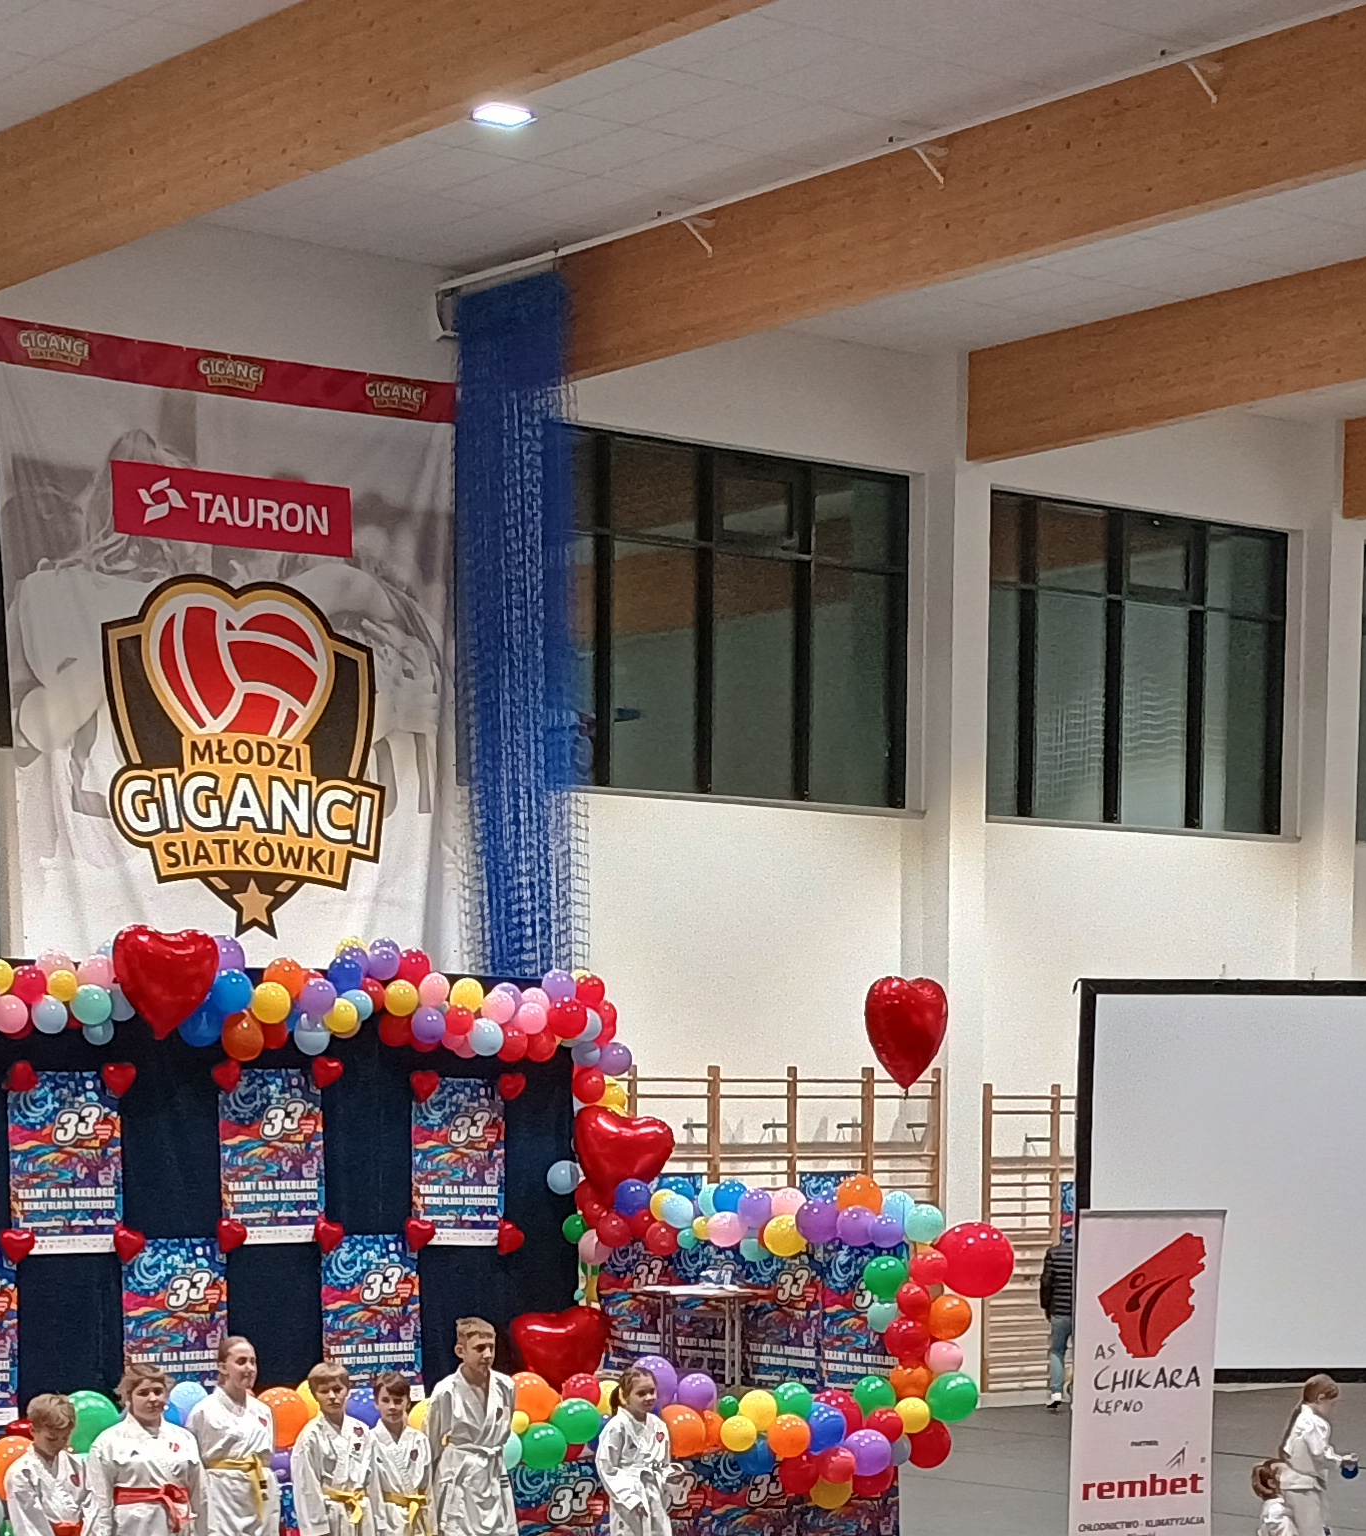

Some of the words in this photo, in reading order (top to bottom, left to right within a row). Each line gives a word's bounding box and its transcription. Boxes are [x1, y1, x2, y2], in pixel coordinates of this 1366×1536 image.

[19, 332, 89, 358] GIGANCI
[199, 359, 264, 383] GIGANCI
[366, 382, 427, 405] GIGANCI
[191, 490, 329, 535] TAURON
[189, 738, 303, 774] MŁODZI
[122, 775, 373, 848] GIGANCI
[166, 834, 336, 877] SIATKÓWKI
[54, 1104, 102, 1142] 33
[262, 1100, 306, 1138] 33
[450, 1109, 492, 1144] 33
[167, 1271, 212, 1308] 33
[363, 1266, 403, 1301] 33
[776, 1267, 810, 1302] 33
[1094, 1342, 1117, 1361] AS
[1093, 1365, 1201, 1392] CHIKARA
[1092, 1398, 1143, 1417] KĘPNO
[549, 1480, 595, 1522] 33
[1082, 1473, 1205, 1501] rembet
